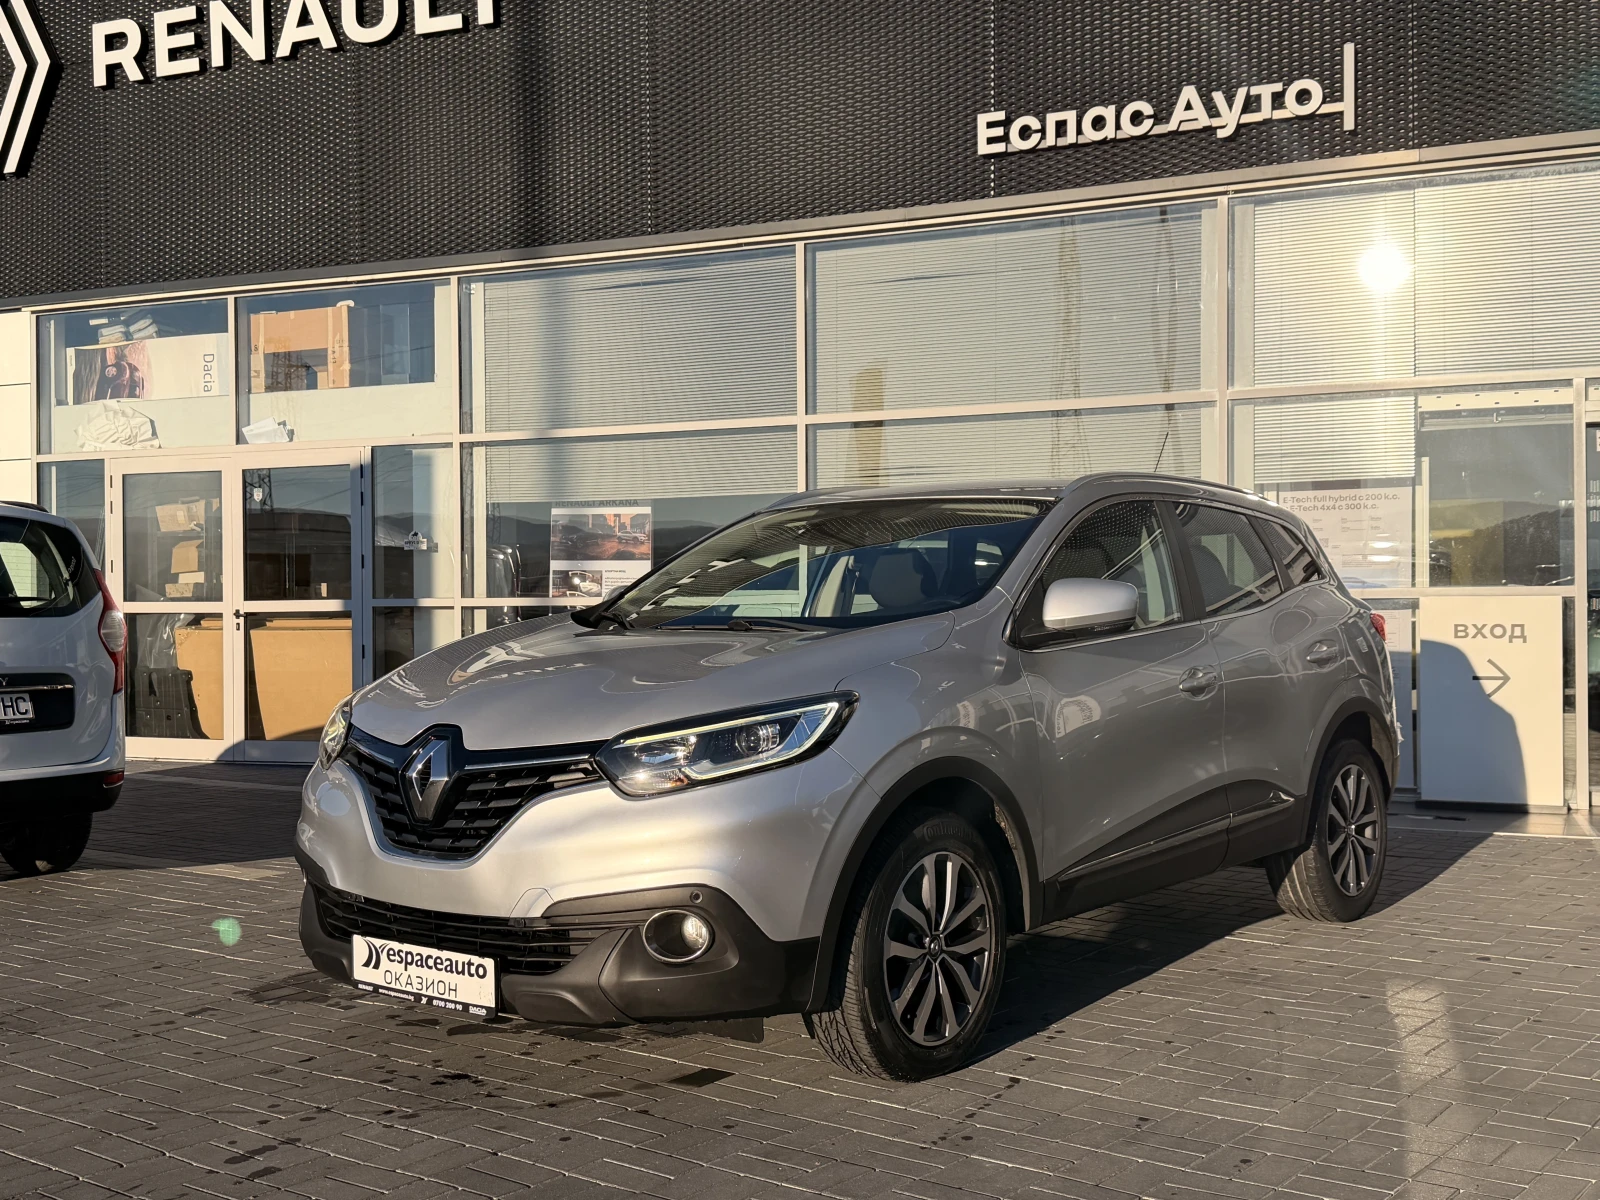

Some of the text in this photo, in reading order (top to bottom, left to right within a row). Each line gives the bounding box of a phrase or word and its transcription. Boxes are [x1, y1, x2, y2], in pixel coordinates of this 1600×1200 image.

[977, 78, 1323, 156] Еспас Ауто
[203, 353, 215, 392] Dacia
[1283, 496, 1312, 504] E-Tech
[1313, 495, 1327, 503] full
[1328, 494, 1357, 504] hybrid
[1365, 493, 1382, 501] 200
[1320, 503, 1337, 511] 4x4
[386, 947, 488, 979] espaceauto
[383, 969, 458, 999] ОКАЗИОН
